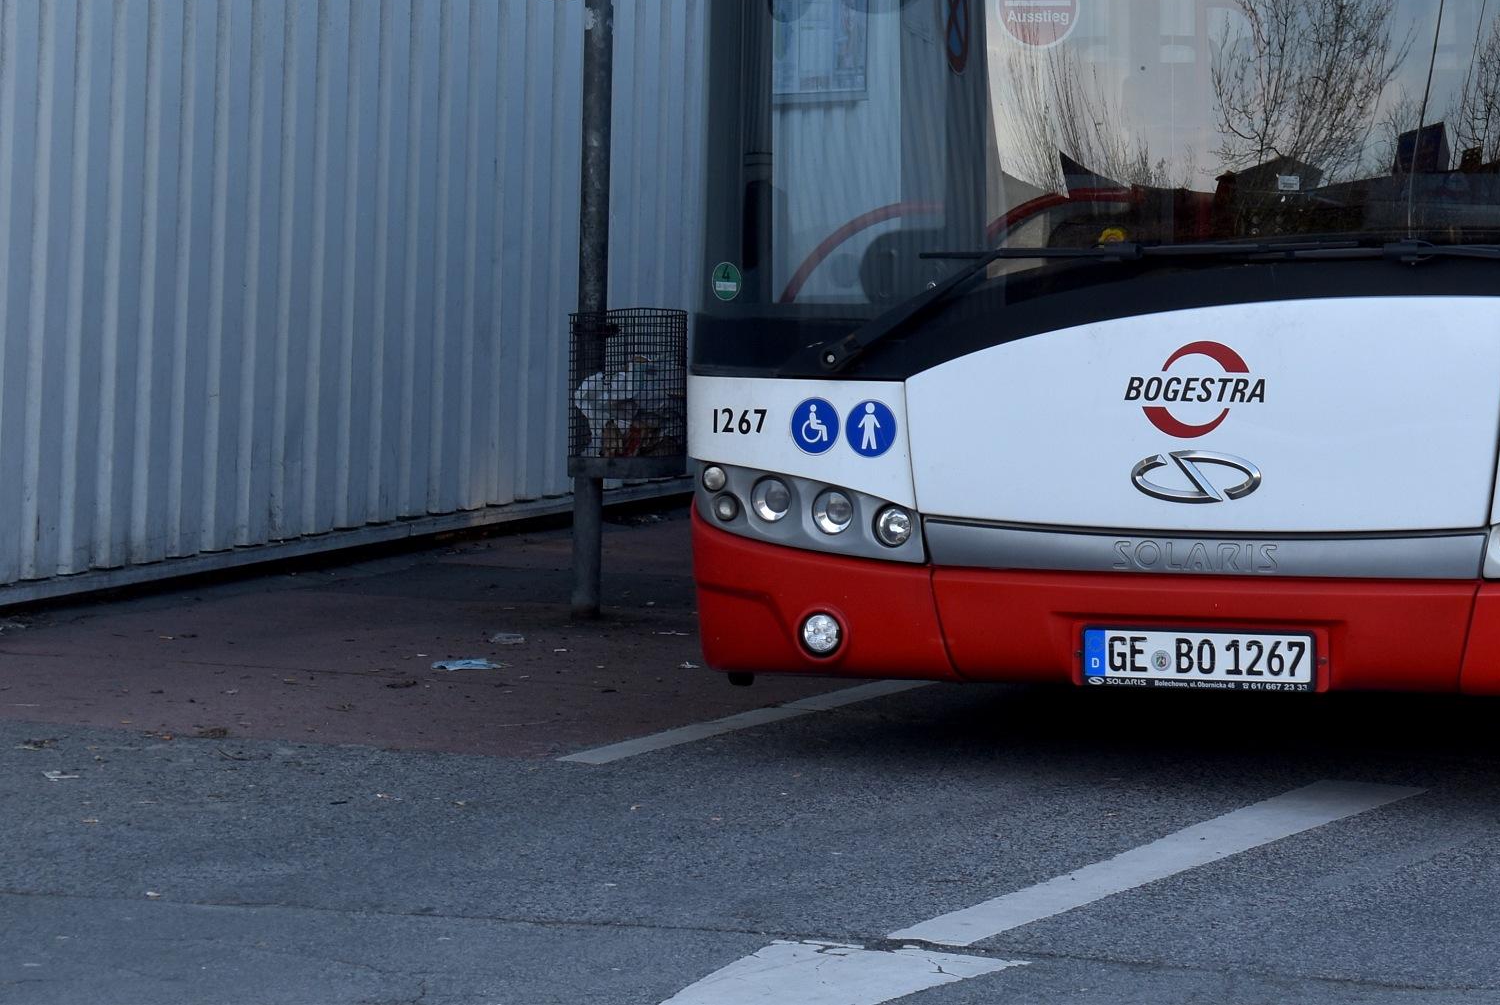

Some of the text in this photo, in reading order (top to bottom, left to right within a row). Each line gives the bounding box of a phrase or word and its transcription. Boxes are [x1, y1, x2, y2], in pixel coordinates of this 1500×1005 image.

[1007, 9, 1069, 26] Ausstieg
[1124, 376, 1266, 403] BOGESTRA
[713, 408, 768, 435] 1267
[1113, 539, 1279, 573] SOLARIS
[1091, 657, 1100, 668] D
[1108, 636, 1306, 677] GE BO 1267
[1106, 678, 1147, 686] SOLARIS
[1154, 680, 1190, 689] Bolechowo,
[1284, 684, 1295, 692] 23
[1297, 684, 1308, 693] 33
